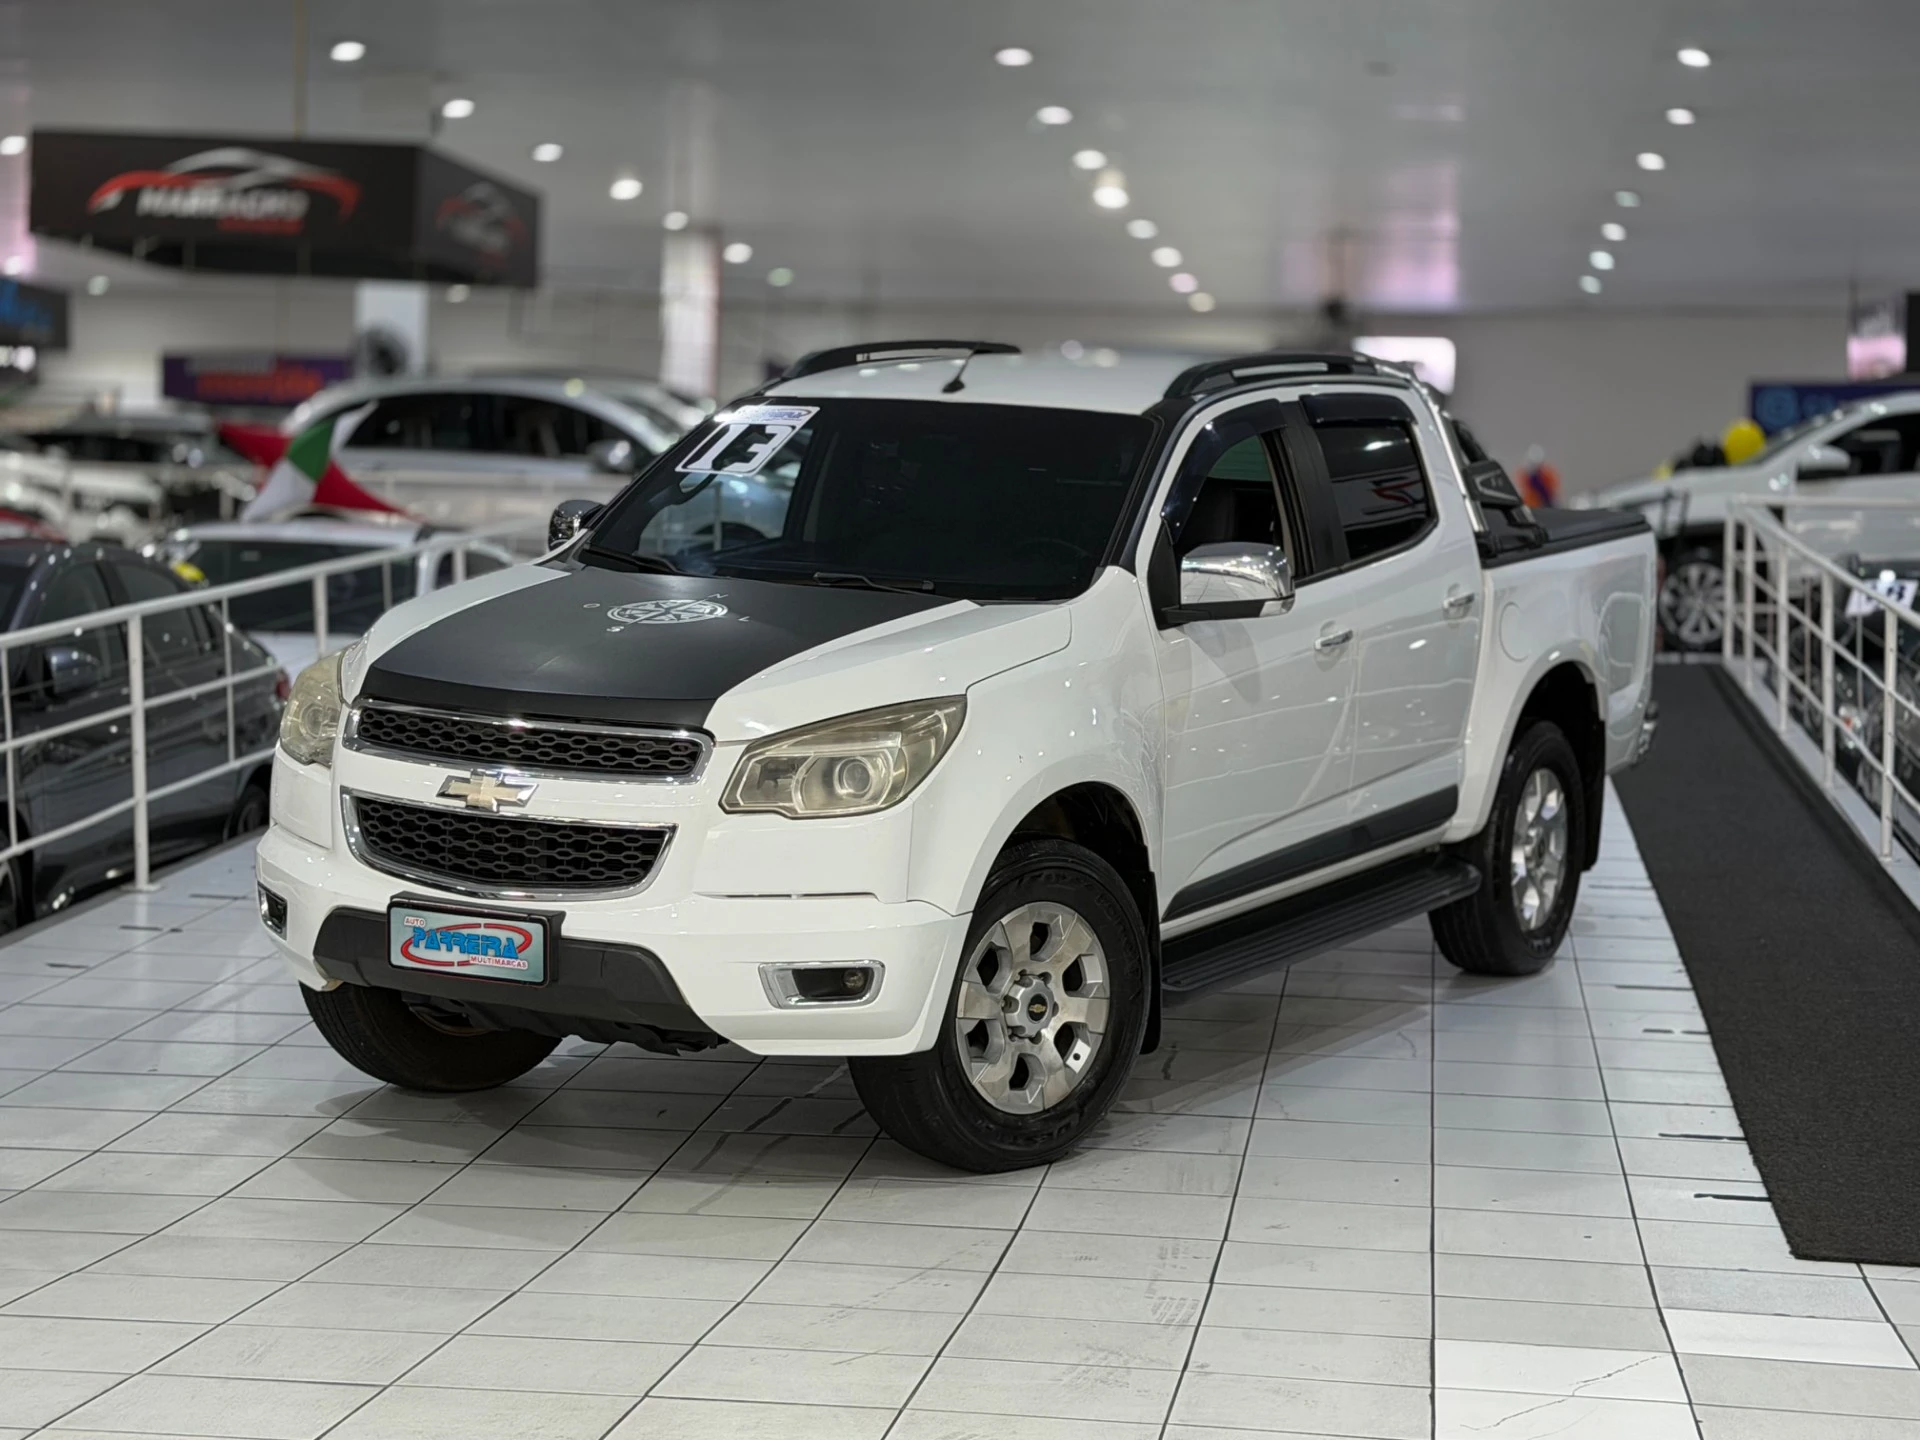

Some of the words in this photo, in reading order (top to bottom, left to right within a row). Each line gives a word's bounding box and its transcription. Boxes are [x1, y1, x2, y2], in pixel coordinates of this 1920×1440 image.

[405, 918, 425, 926] AUTO
[413, 927, 519, 959] PARREIRA
[470, 956, 527, 968] MULTIMARCAS
